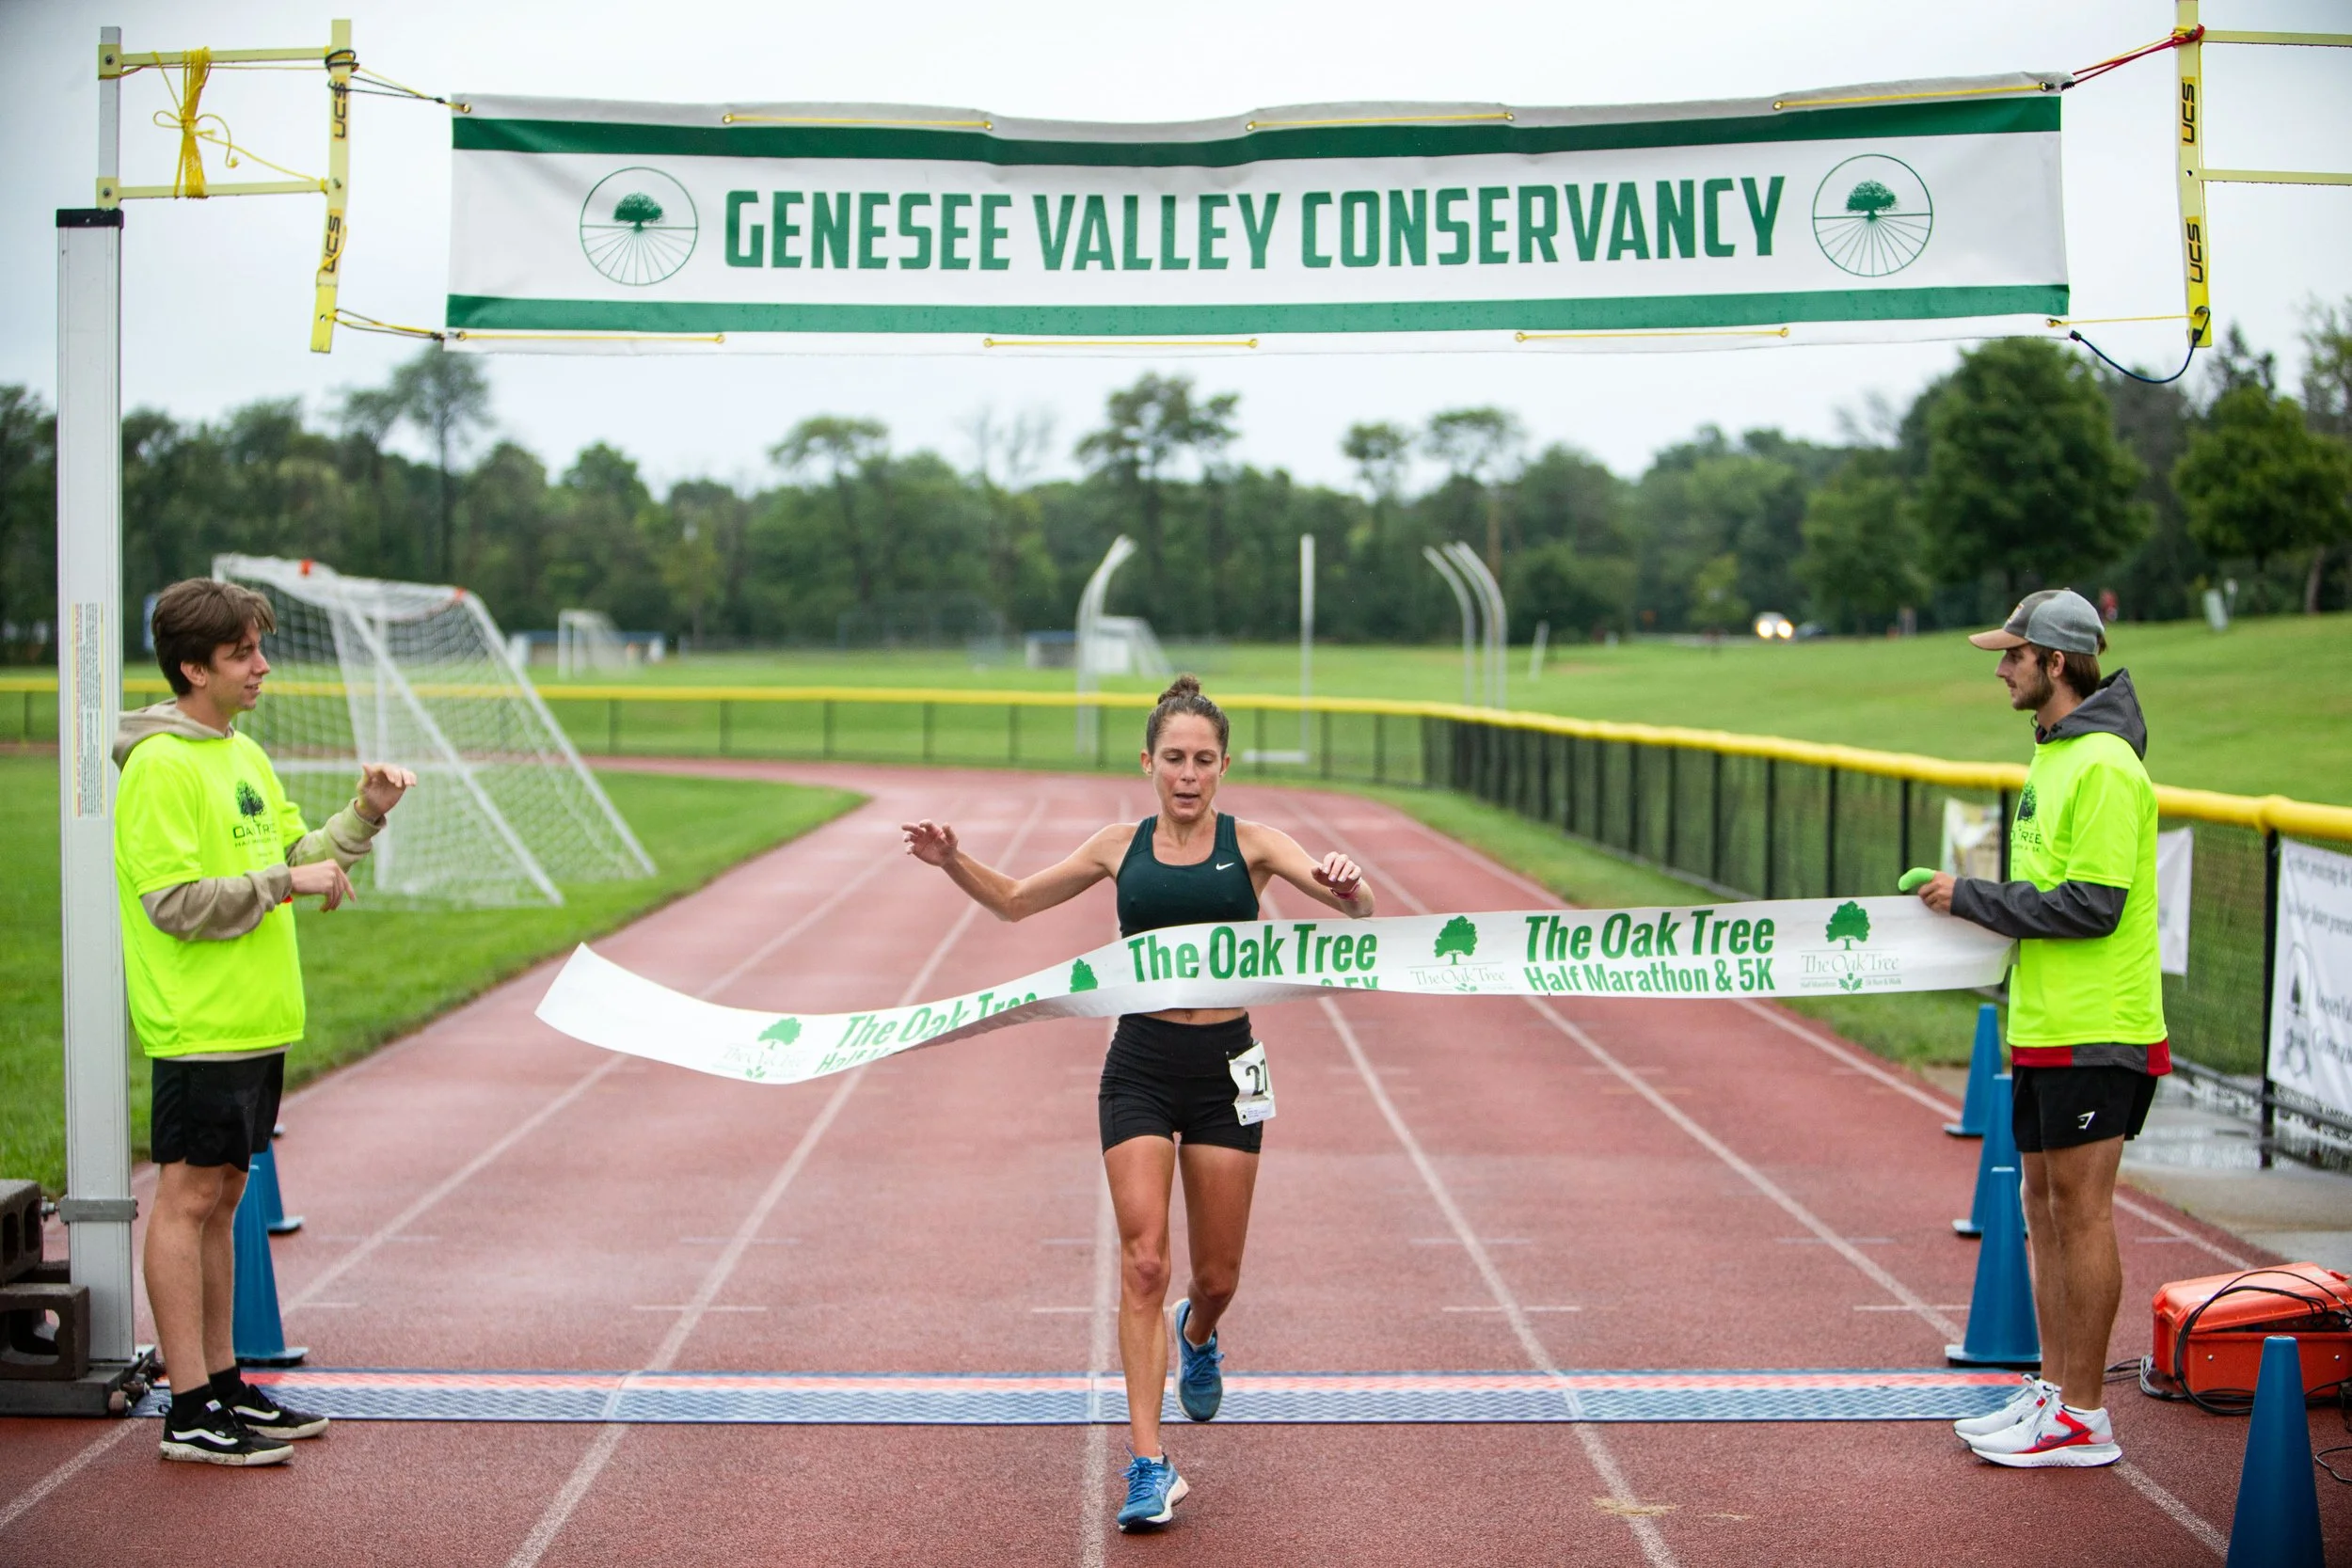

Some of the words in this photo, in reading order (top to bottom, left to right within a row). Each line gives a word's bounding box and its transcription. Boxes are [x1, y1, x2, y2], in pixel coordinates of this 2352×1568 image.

[334, 81, 346, 139] UCS
[2182, 82, 2195, 144] UCS
[323, 214, 341, 274] UCS
[724, 190, 1013, 271] GENESEE
[1033, 193, 1281, 271] VALLEY
[1301, 176, 1786, 269] CONSERVANCY
[2186, 222, 2203, 284] UCS
[1128, 934, 1200, 984] The
[1209, 925, 1288, 980] Oak
[1293, 924, 1378, 974] Tree
[1525, 915, 1592, 962] The
[1600, 911, 1681, 959] Oak
[1691, 910, 1775, 956] Tree
[1801, 954, 1829, 973] The
[1832, 953, 1865, 972] Oak
[1866, 953, 1899, 971] Tree
[1523, 963, 1587, 992] Half
[1582, 960, 1708, 992] Marathon
[1714, 958, 1733, 992] &
[1740, 958, 1775, 990] 5K
[836, 1015, 897, 1049] The
[899, 1001, 971, 1041] Oak
